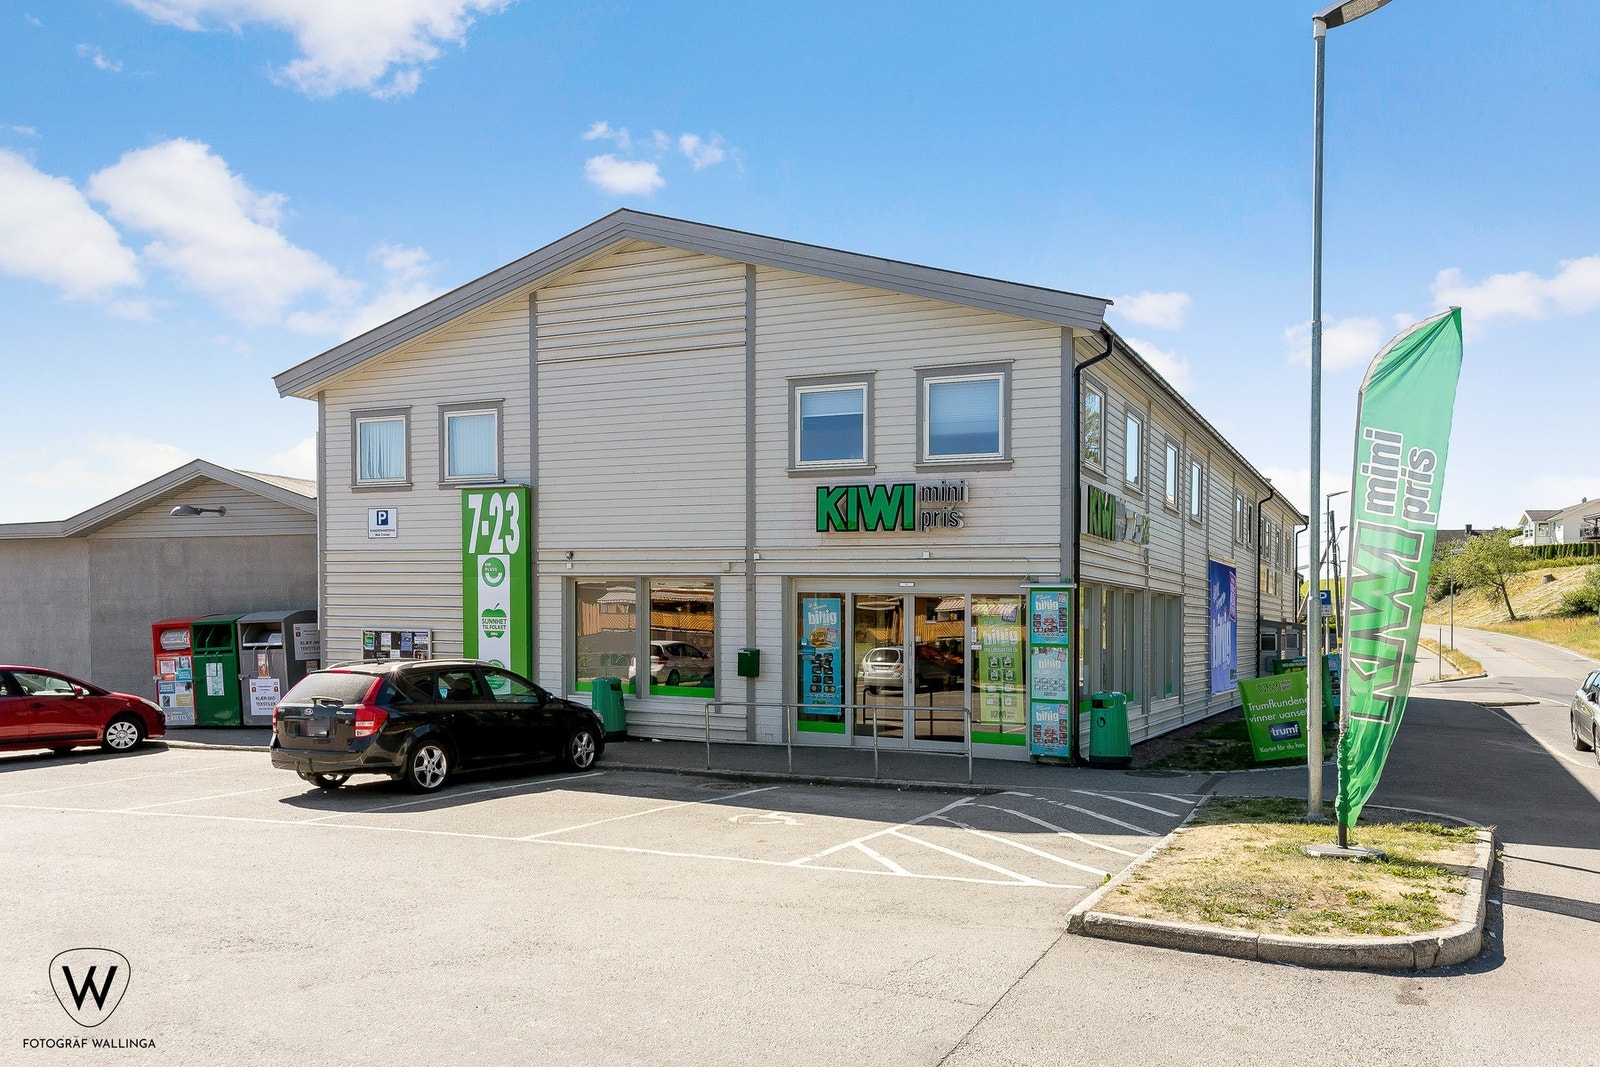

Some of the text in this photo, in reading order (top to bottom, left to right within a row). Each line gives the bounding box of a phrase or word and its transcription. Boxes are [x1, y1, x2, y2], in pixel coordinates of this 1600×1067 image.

[1361, 427, 1404, 517] mini
[920, 480, 967, 503] mini
[1402, 445, 1438, 525] pris
[816, 483, 916, 532] KIWI
[378, 511, 387, 525] P
[468, 492, 520, 554] 7-23
[921, 506, 965, 533] pris
[1035, 599, 1059, 610] billig
[808, 609, 837, 625] billig
[983, 628, 1019, 646] billig
[1036, 710, 1059, 722] billig
[1249, 712, 1276, 722] vinner
[1271, 724, 1299, 736] trumf
